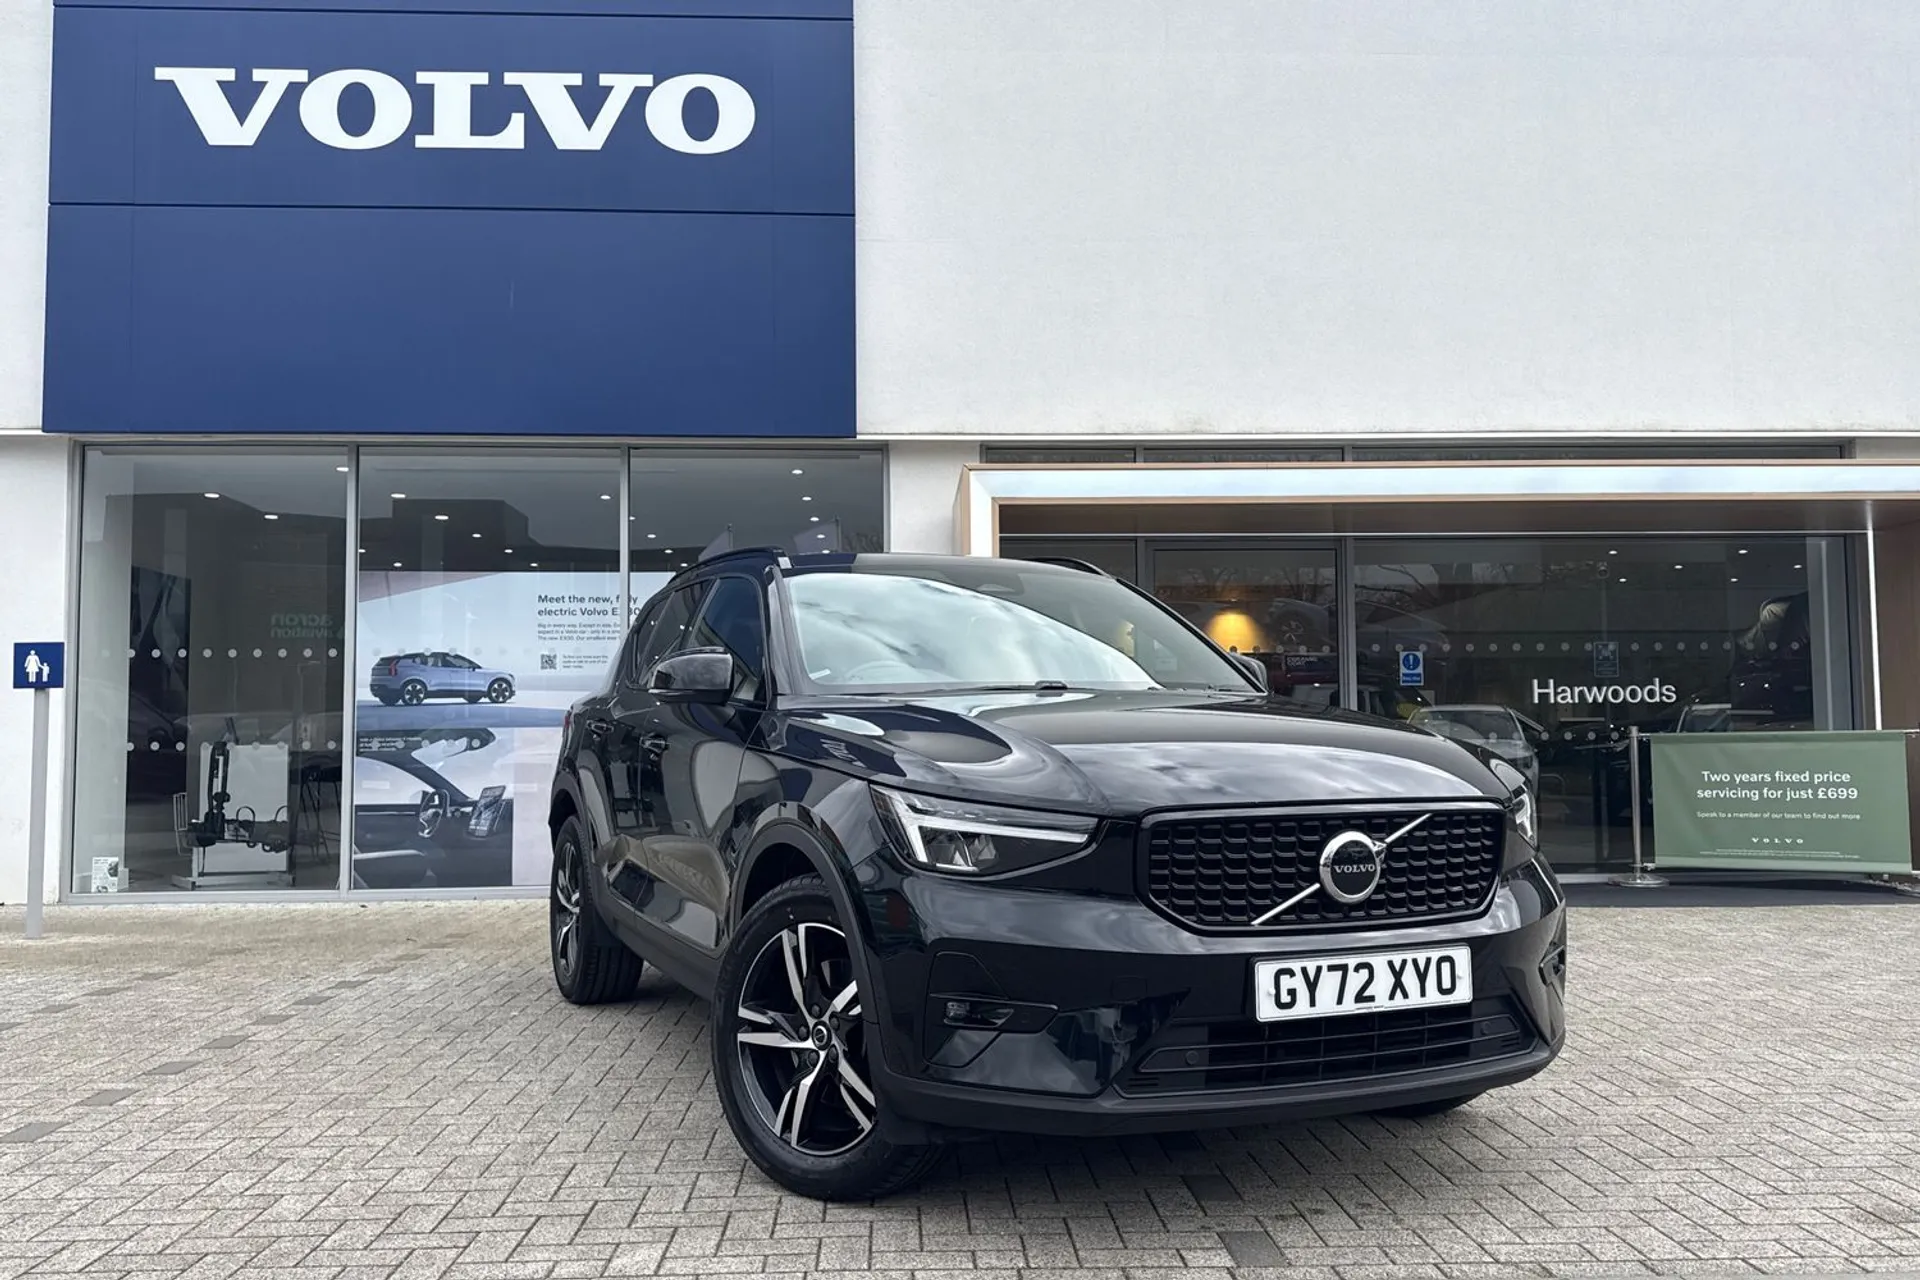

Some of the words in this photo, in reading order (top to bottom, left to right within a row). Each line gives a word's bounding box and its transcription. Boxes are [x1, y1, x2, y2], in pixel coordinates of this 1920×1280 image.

[154, 66, 756, 155] VOLVO
[537, 594, 565, 604] Meet
[568, 594, 586, 604] the
[588, 596, 613, 605] new,
[616, 594, 639, 605] fly
[537, 606, 577, 616] electric
[580, 606, 608, 616] Volvo
[611, 606, 641, 616] E30
[1531, 677, 1677, 704] Harwoods
[1701, 770, 1731, 783] Two
[1734, 773, 1772, 785] years
[1775, 770, 1810, 783] fixed
[1814, 770, 1851, 785] price
[1696, 787, 1759, 801] servicing
[1763, 787, 1783, 799] for
[1786, 787, 1814, 802] just
[1817, 787, 1858, 800] £699
[1696, 811, 1718, 819] Speak
[1733, 811, 1761, 819] member
[1333, 863, 1376, 873] VOLVO
[1273, 961, 1376, 1010] GY72
[1387, 955, 1456, 1001] XYO
